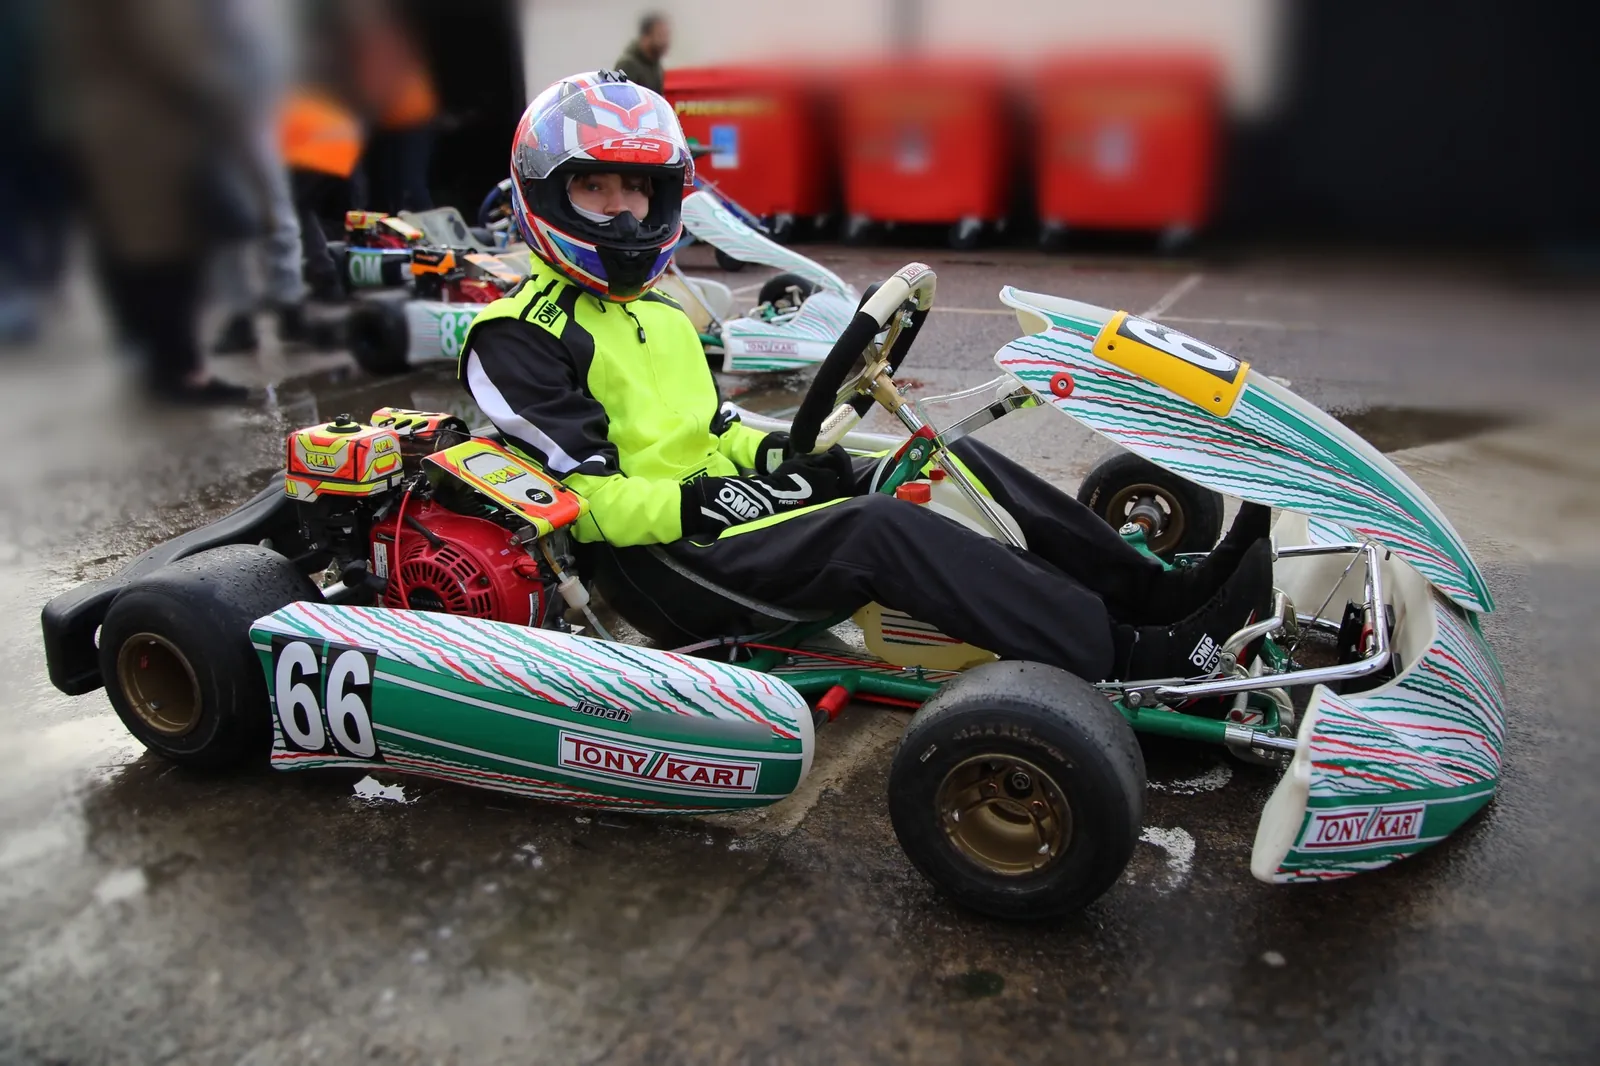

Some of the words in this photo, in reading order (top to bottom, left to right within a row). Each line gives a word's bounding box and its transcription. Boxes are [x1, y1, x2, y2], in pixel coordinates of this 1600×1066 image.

[602, 138, 661, 153] LS2
[537, 302, 559, 324] OMP
[1126, 320, 1236, 372] 6
[718, 487, 760, 519] OMP
[1192, 636, 1214, 667] OMP
[1204, 645, 1222, 674] SPORT
[275, 640, 376, 758] 66
[571, 701, 632, 722] Jonah
[565, 737, 648, 774] TONY
[667, 758, 756, 786] KART
[1316, 811, 1369, 842] TONY
[1375, 808, 1423, 837] KART
